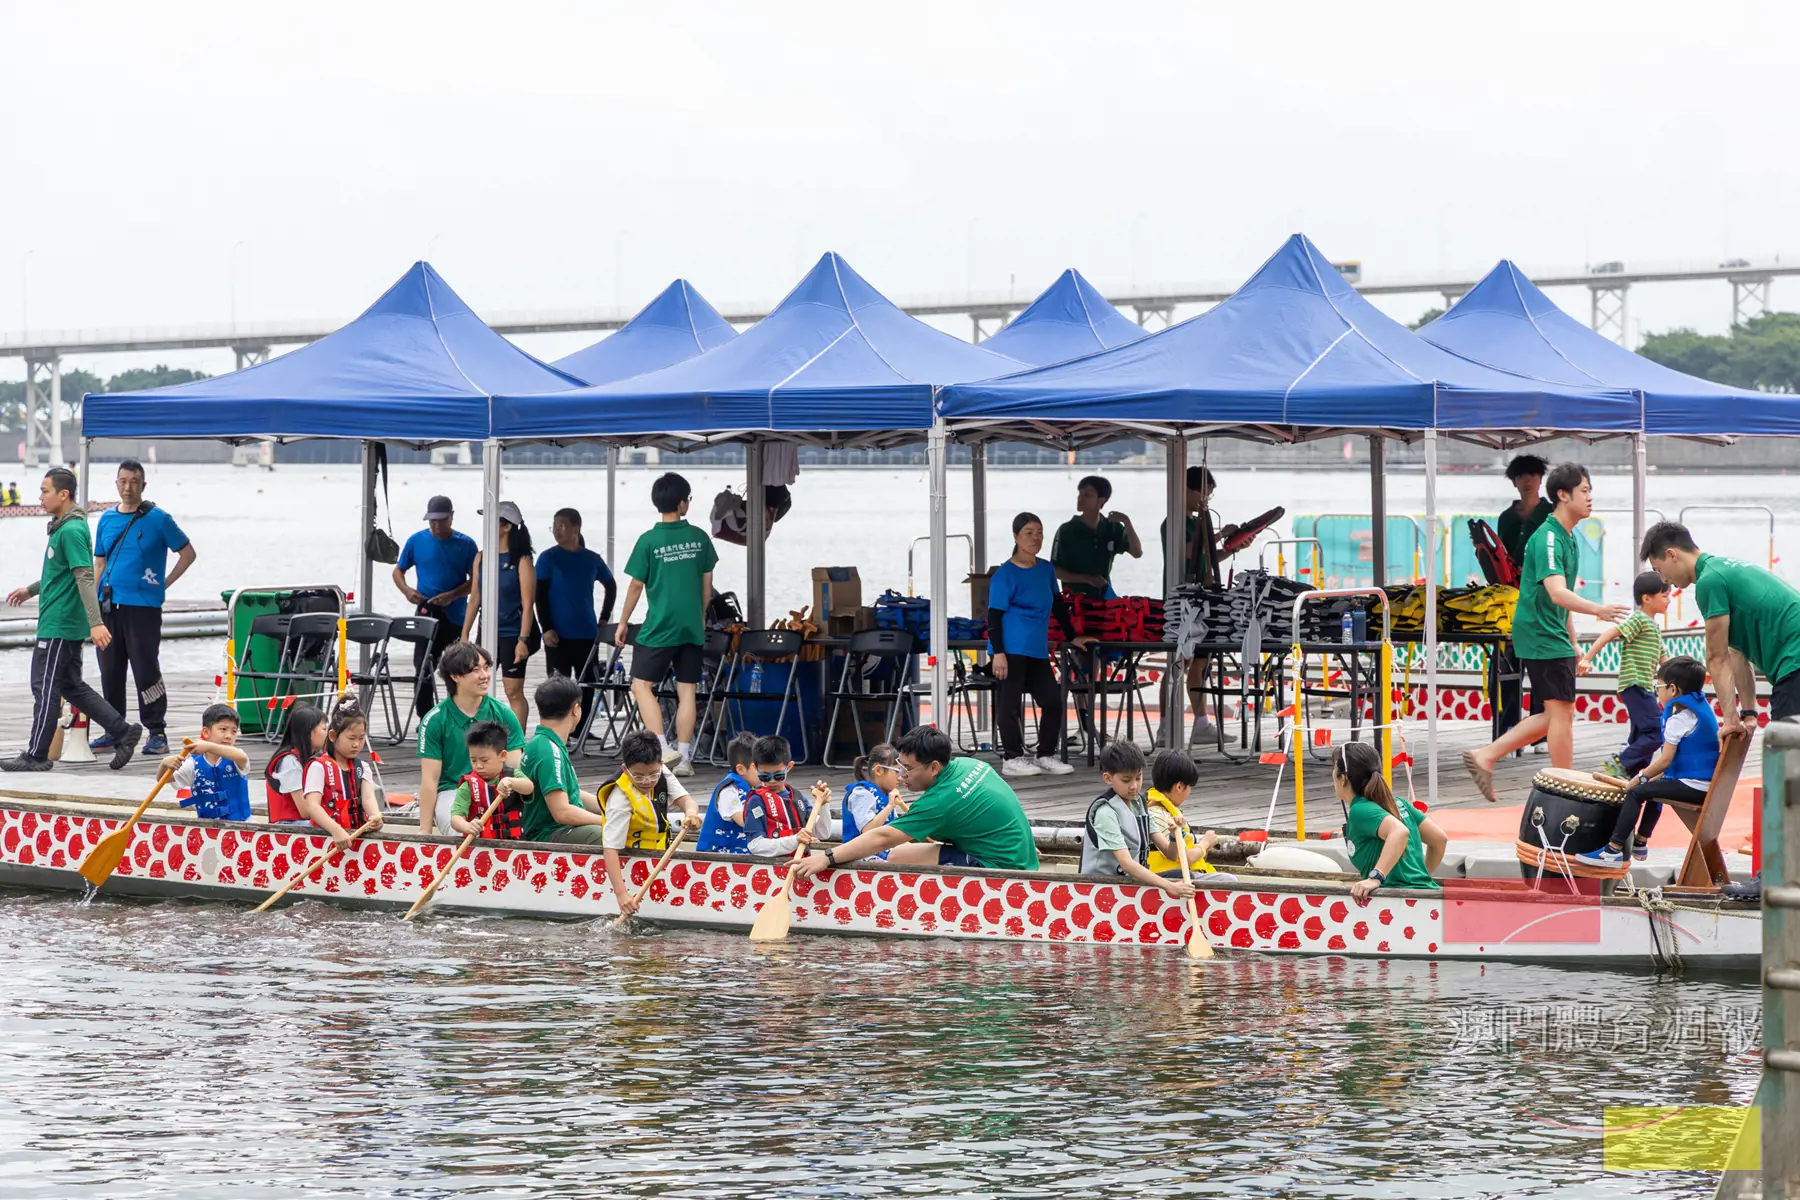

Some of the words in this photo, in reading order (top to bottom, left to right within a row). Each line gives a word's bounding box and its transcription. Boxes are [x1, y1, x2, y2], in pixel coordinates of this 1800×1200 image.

[325, 760, 336, 786] HISEA
[470, 776, 481, 802] HISEA
[765, 792, 778, 817] HISEA
